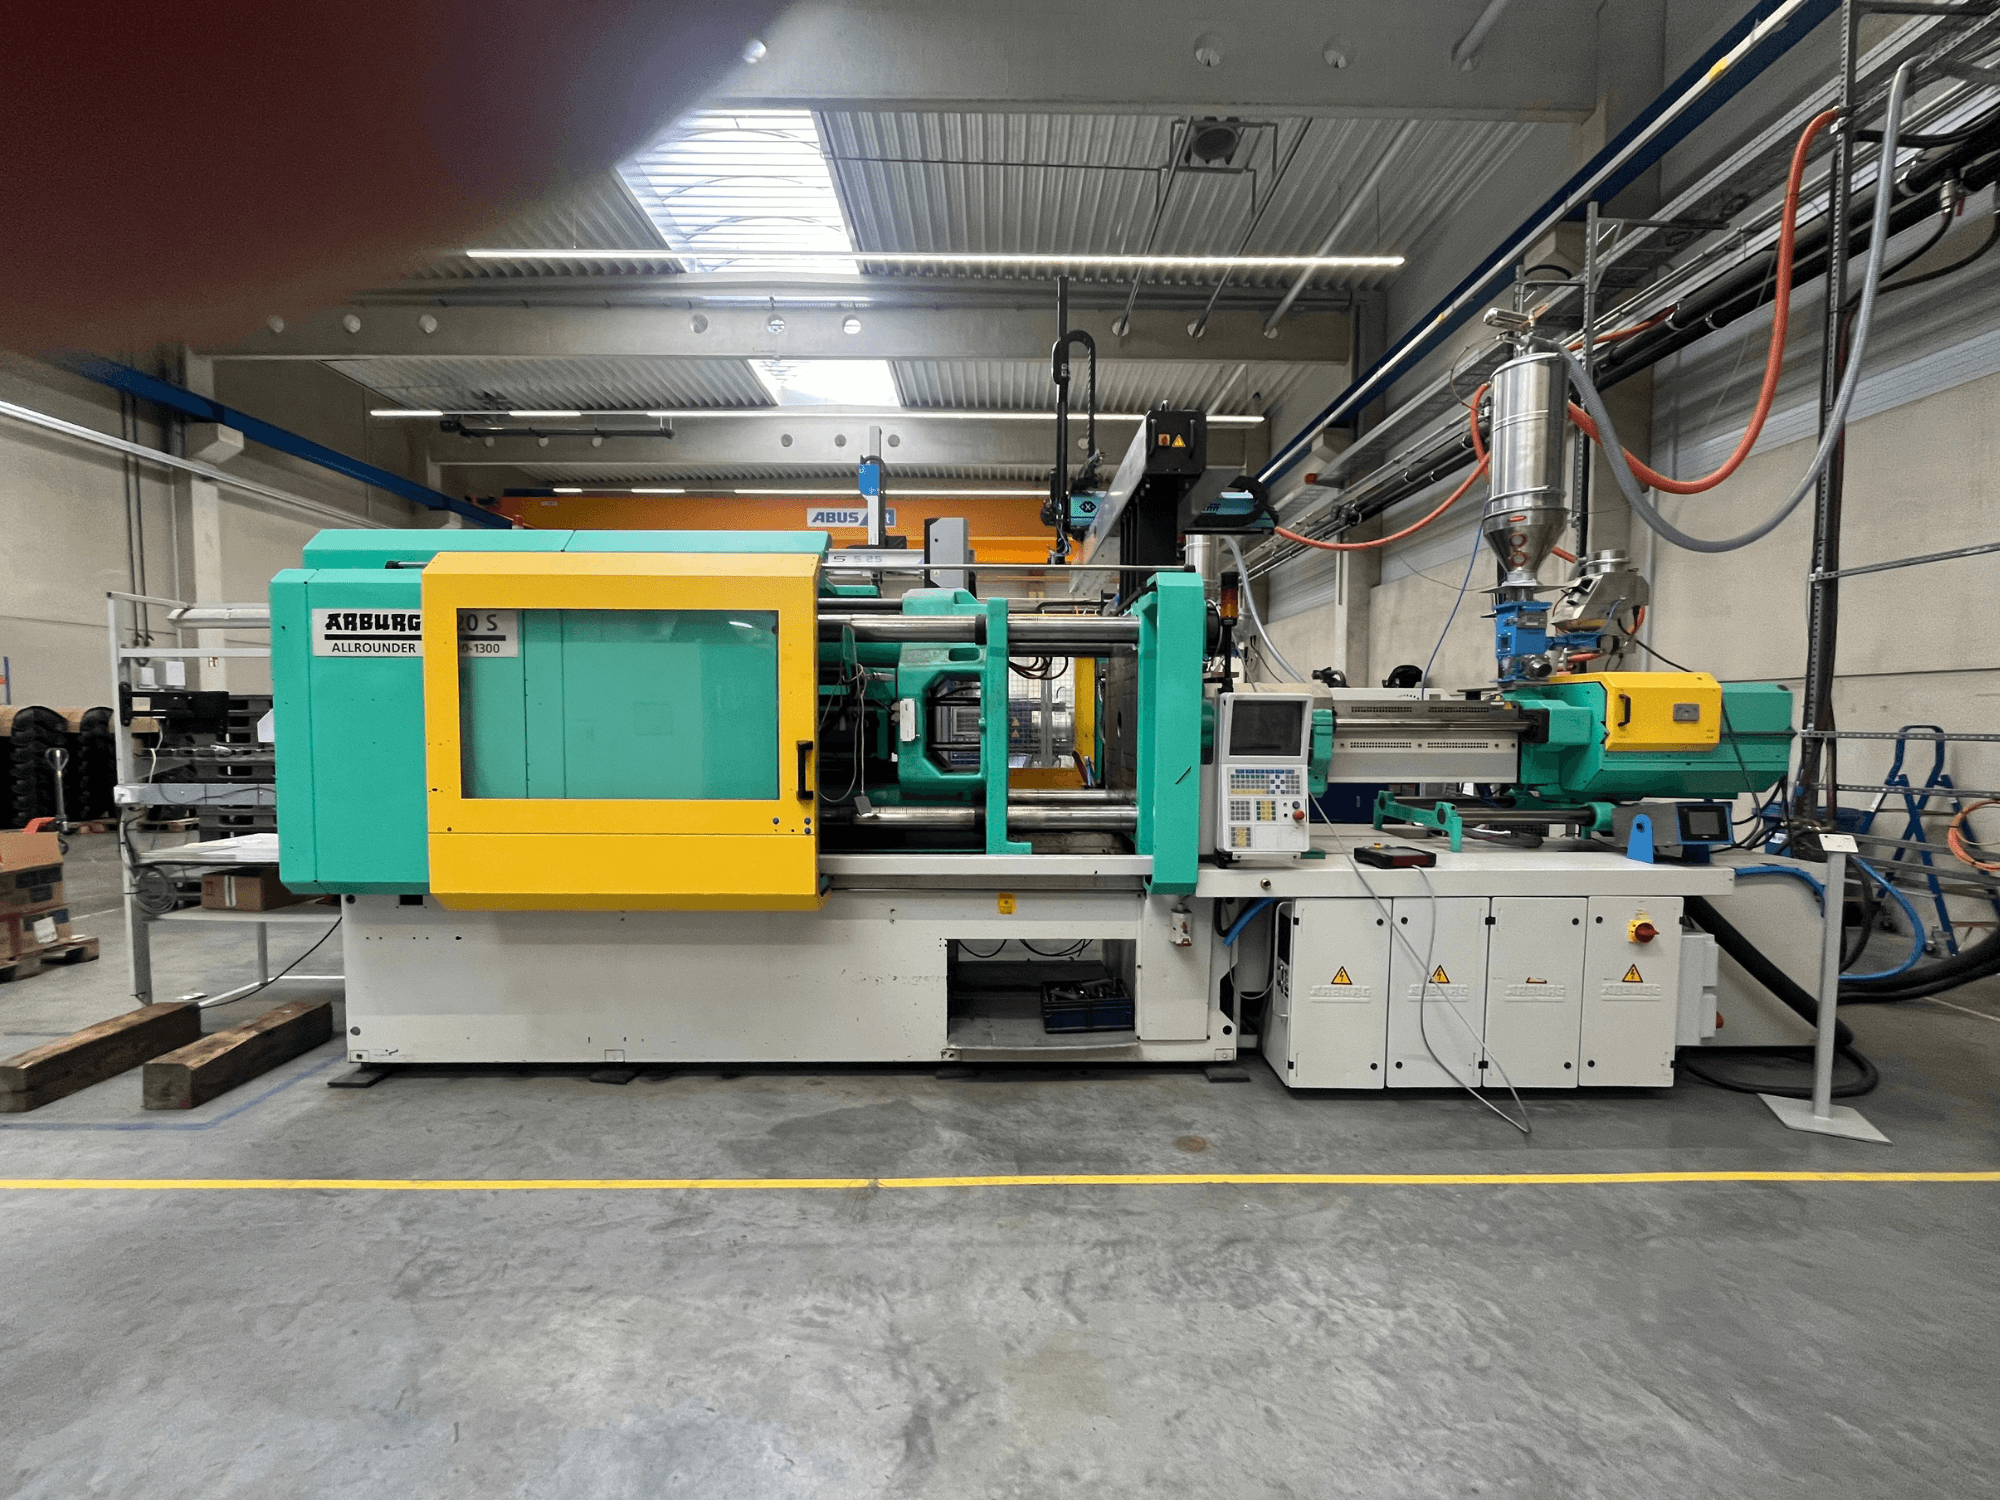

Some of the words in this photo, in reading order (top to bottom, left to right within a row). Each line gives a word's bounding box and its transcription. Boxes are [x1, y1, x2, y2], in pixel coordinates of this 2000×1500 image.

[811, 512, 859, 524] ABUS
[325, 613, 421, 632] ARBURG
[486, 614, 498, 631] S
[331, 643, 416, 653] ALLROUNDER
[459, 643, 500, 653] 0-1300
